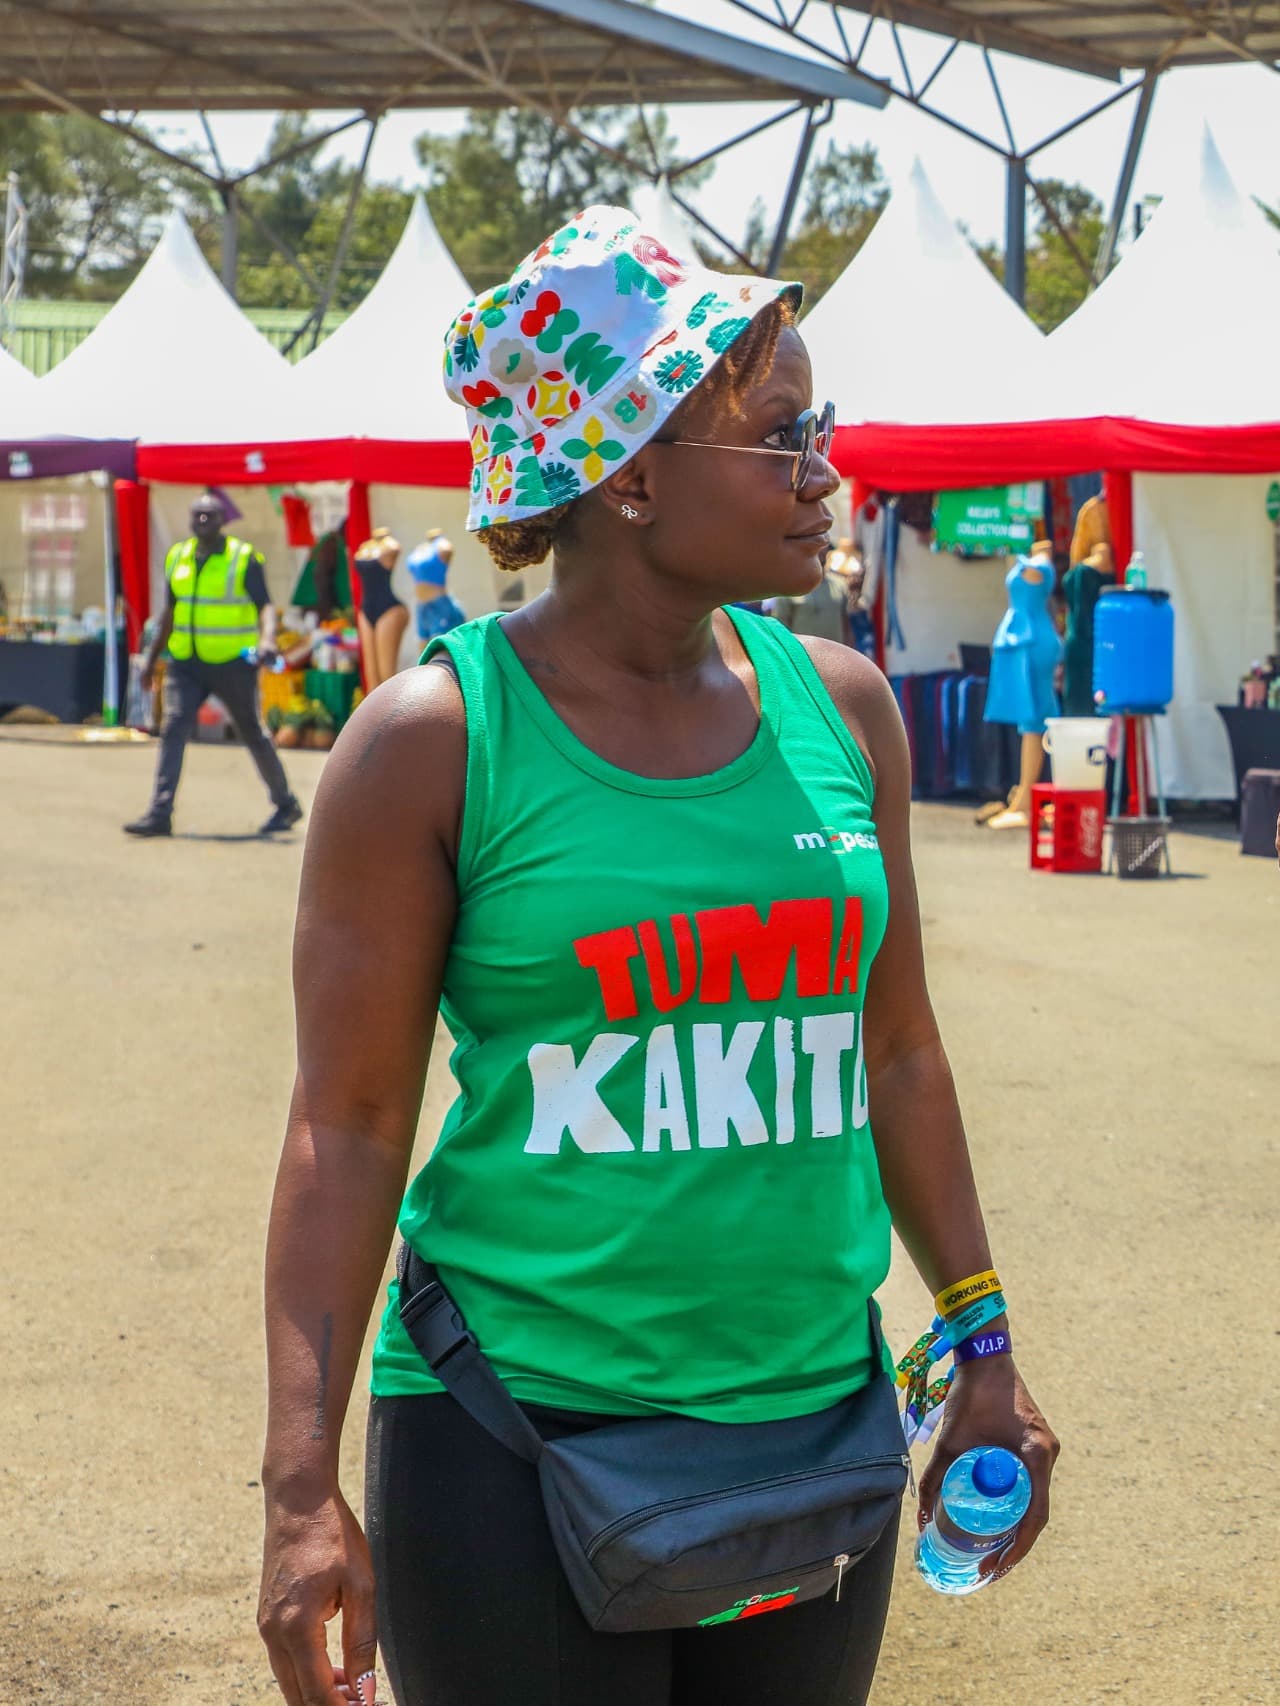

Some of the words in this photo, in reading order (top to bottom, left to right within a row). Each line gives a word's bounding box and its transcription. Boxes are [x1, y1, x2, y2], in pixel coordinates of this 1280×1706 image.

[571, 896, 863, 1022] TUMA
[943, 1280, 989, 1307] WORKING
[973, 1336, 1004, 1355] V.I.P
